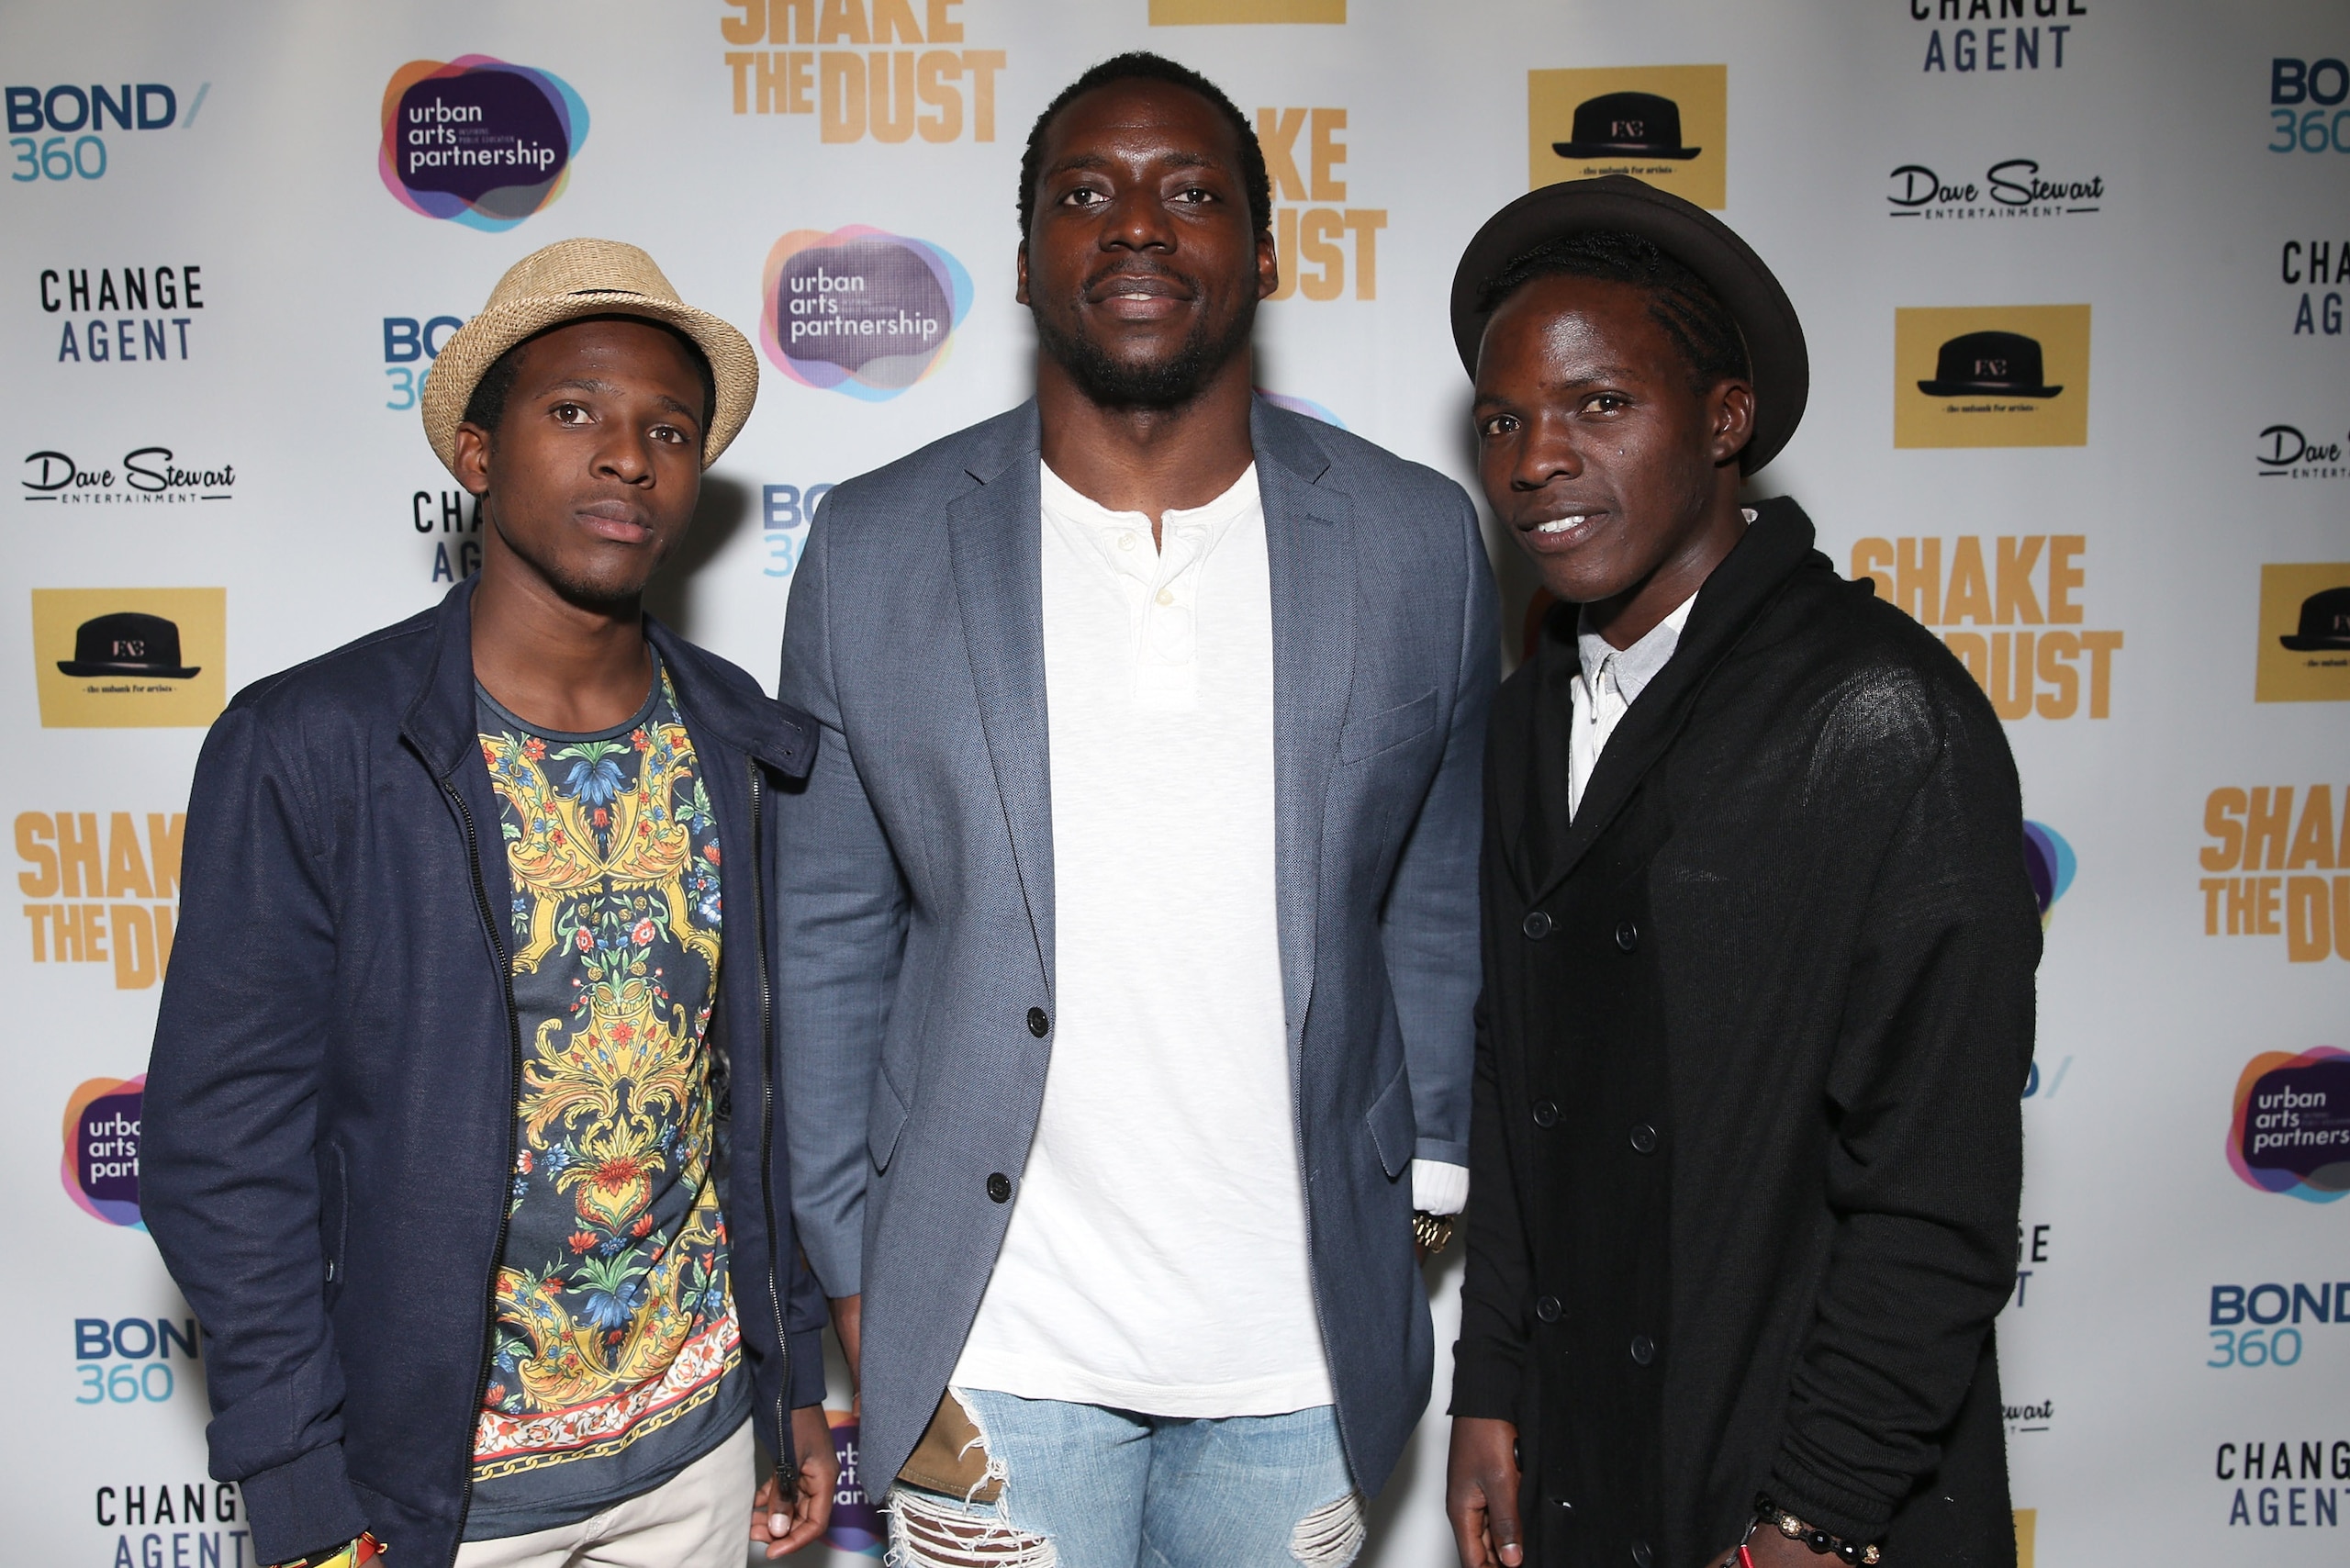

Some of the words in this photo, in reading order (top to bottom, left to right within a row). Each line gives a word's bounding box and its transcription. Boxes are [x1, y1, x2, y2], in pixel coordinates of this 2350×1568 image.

[1923, 25, 2071, 73] AGENT
[409, 96, 482, 123] urban
[725, 51, 814, 115] THE
[820, 50, 1007, 144] DUST
[408, 125, 456, 145] arts
[9, 135, 107, 182] 360
[410, 140, 555, 174] partnership
[1887, 165, 1978, 207] Dave
[1987, 159, 2104, 206] Stewart
[1925, 207, 2063, 219] ENTERTAINMENT
[40, 265, 204, 313] CHANGE
[790, 266, 865, 293] urban
[789, 294, 838, 315] arts
[58, 318, 191, 363] AGENT
[791, 308, 938, 343] partnership
[2256, 424, 2342, 466] Dave
[22, 451, 116, 491] Dave
[123, 447, 236, 492] Stewart
[2292, 467, 2350, 478] ENTERT
[62, 492, 196, 504] ENTERTAINMENT
[1851, 535, 2086, 626] SHAKE
[2199, 877, 2282, 935] THE
[23, 904, 108, 962] THE
[2258, 1085, 2326, 1109] urban
[2255, 1109, 2300, 1129] arts
[89, 1137, 137, 1158] arts
[75, 1317, 203, 1360] BON
[2207, 1327, 2302, 1368] 360
[75, 1362, 173, 1405] 360
[96, 1483, 249, 1527] CHANG
[2229, 1487, 2350, 1527] AGEN
[115, 1530, 249, 1568] AGENT
